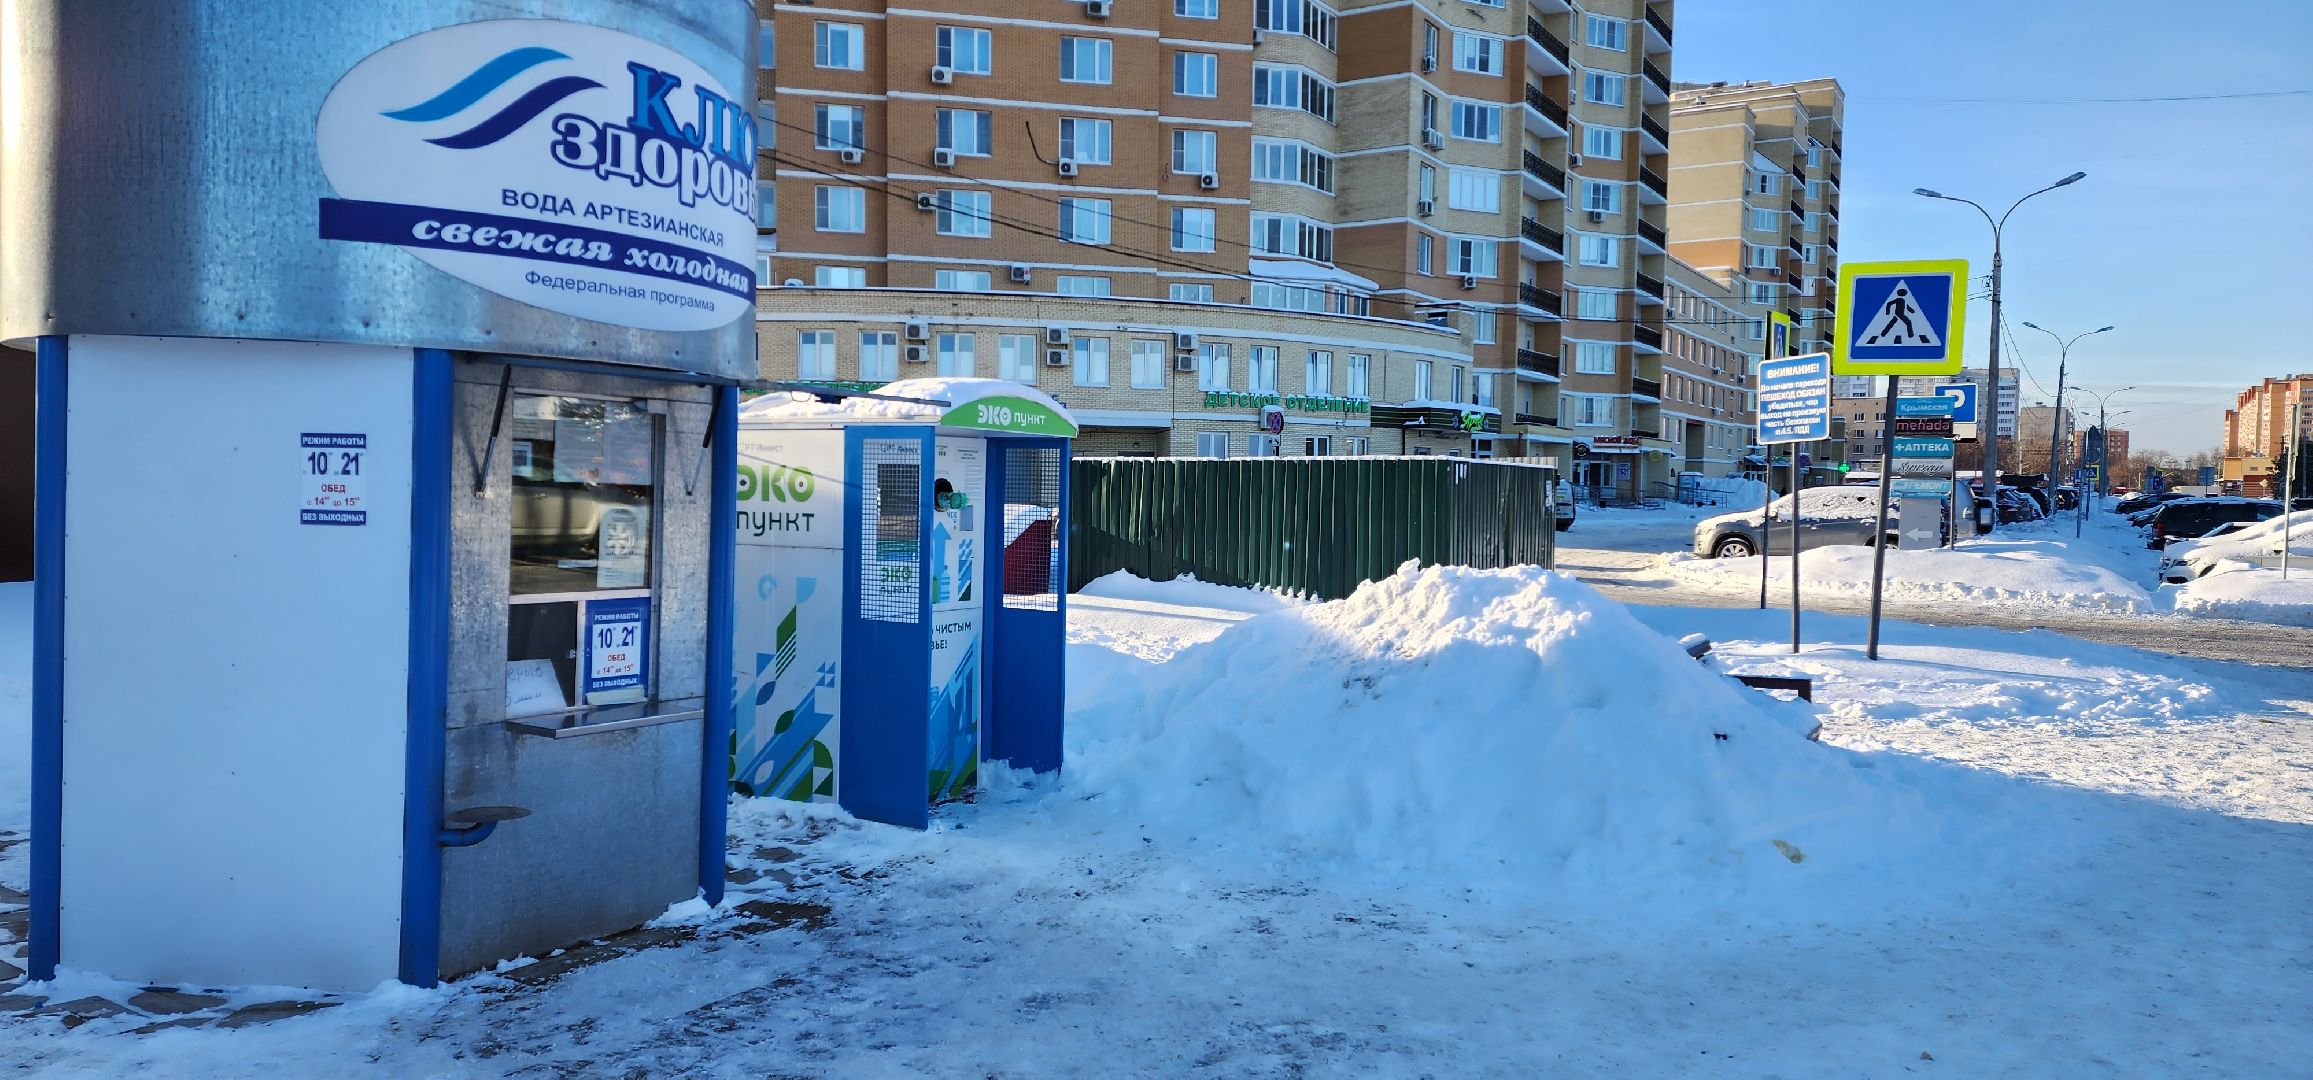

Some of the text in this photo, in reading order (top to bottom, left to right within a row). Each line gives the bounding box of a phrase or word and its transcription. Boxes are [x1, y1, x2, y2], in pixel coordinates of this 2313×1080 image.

[501, 188, 725, 248] ВОДА АРТЕЗИАНСКАЯ
[411, 219, 749, 294] свежая холодная
[525, 271, 715, 312] Федеральная программа
[1766, 363, 1820, 379] ВНИМАНИЕ!
[1760, 378, 1827, 393] До начала перехода
[1760, 387, 1826, 402] ПЕШЕХОД ОБЯЗАН
[1204, 392, 1370, 413] ДЕТСКОЕ ОТДЕЛЕНИЕ
[1901, 403, 1948, 412] Крымская
[977, 404, 1012, 426] ЭКО
[1792, 407, 1827, 418] проезжую
[302, 437, 364, 446] РЕЖИМ РАБОТЫ
[1904, 443, 1950, 452] АПТЕКА
[321, 484, 346, 493] ОБЕД
[302, 513, 365, 523] БЕЗ ВЫХОДНЫХ
[615, 612, 639, 620] РАБОТЫ
[935, 621, 972, 634] ЧИСТЫМ
[607, 653, 626, 662] ОБЕД
